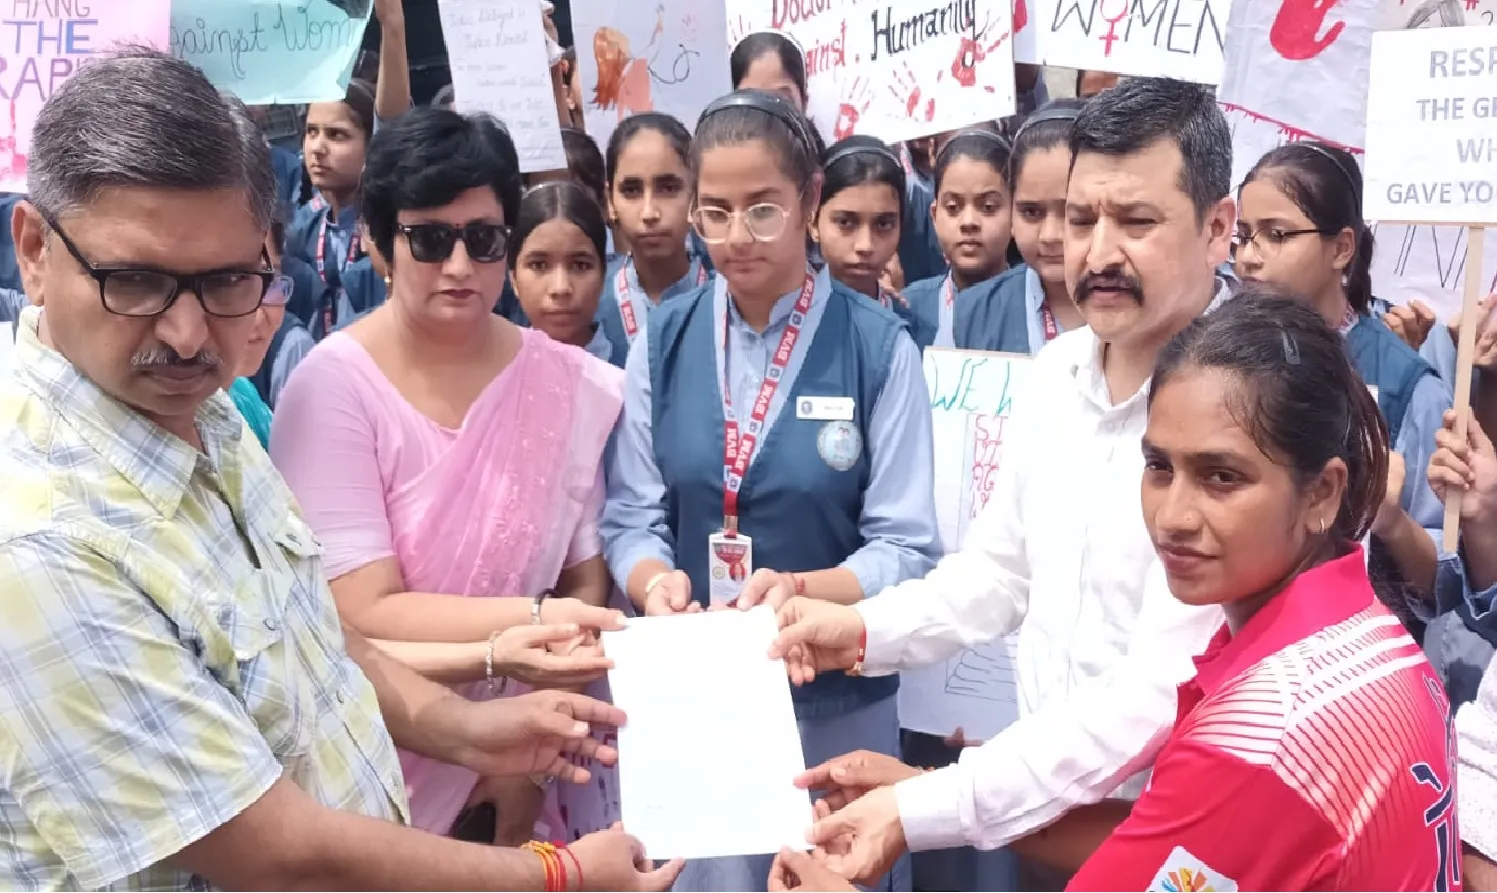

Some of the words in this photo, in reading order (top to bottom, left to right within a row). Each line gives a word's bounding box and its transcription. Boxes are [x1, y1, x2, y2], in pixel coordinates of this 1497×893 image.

[2, 19, 99, 54] THE
[1416, 97, 1465, 121] THE
[1386, 182, 1452, 205] GAVE
[777, 331, 796, 361] BVM
[754, 380, 774, 415] BVM
[726, 427, 738, 459] BVM
[734, 437, 753, 471] BVM
